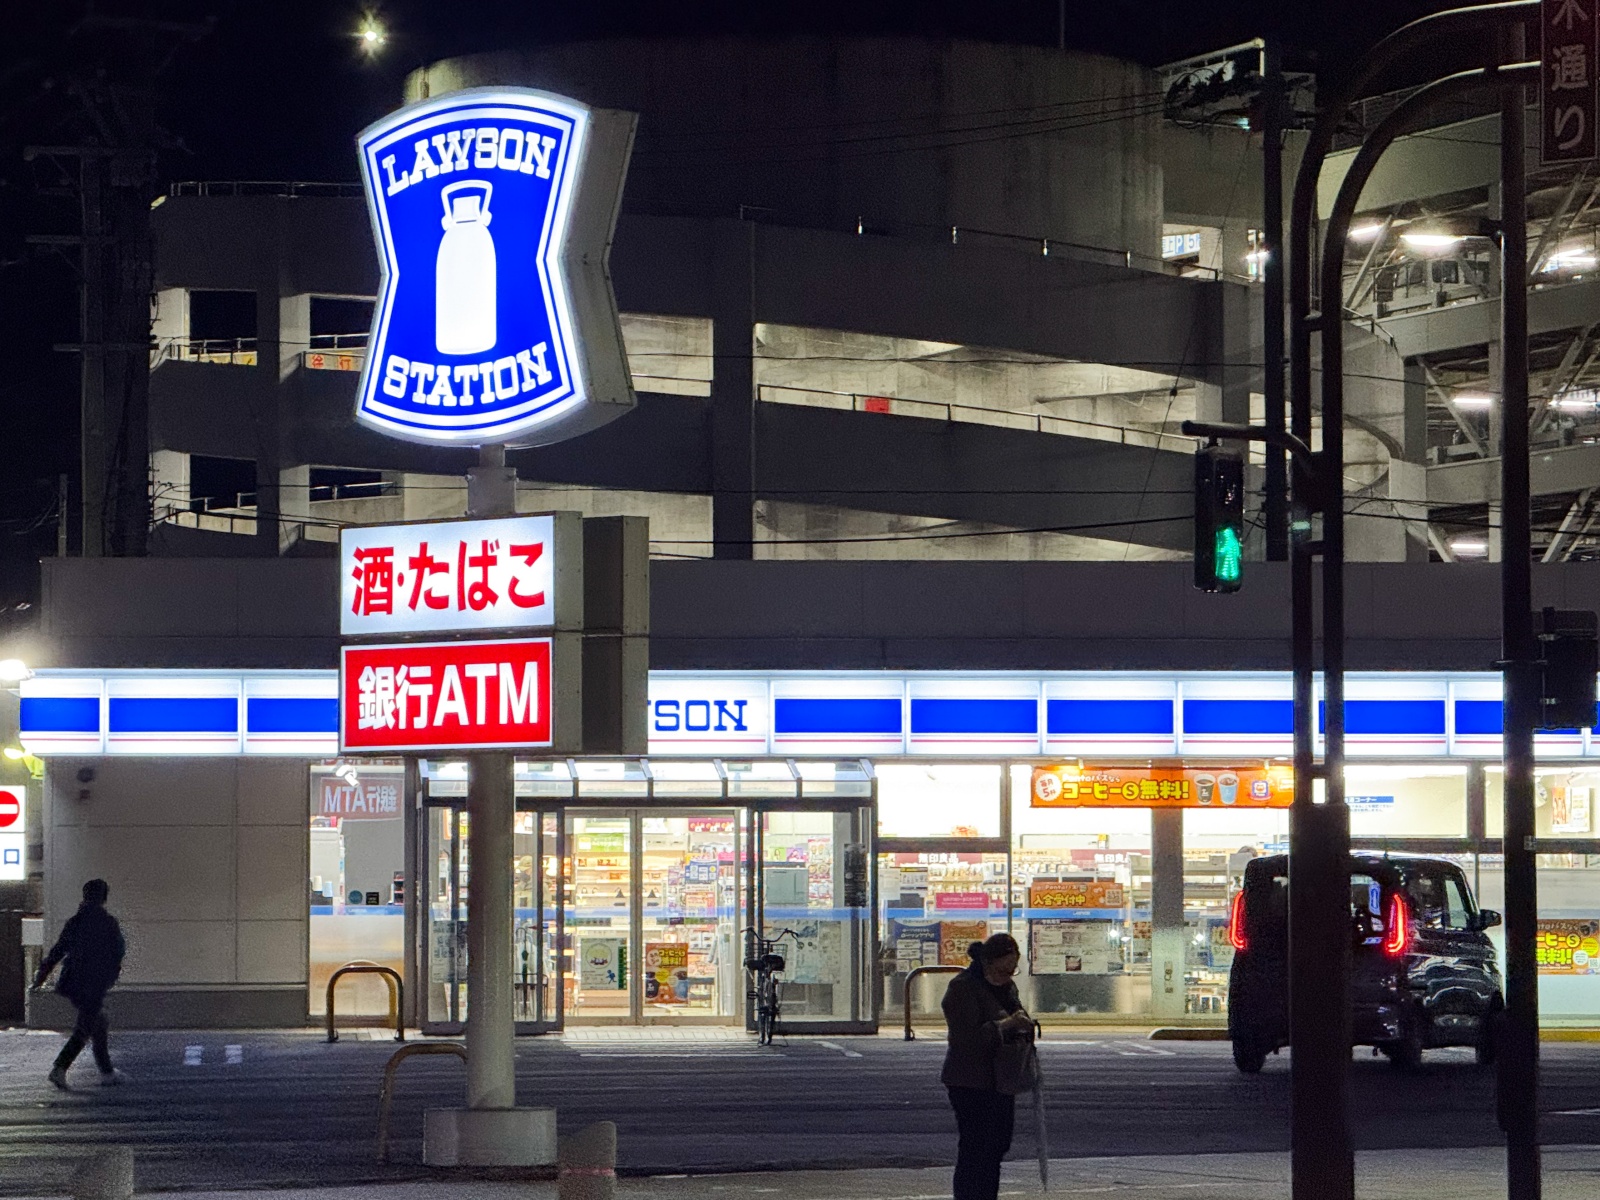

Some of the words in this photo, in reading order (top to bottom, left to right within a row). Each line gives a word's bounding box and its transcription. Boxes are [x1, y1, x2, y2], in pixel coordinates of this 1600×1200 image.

[381, 127, 556, 197] LAWSON
[382, 341, 552, 407] STATION
[357, 661, 539, 730] 銀行ATM
[648, 699, 748, 732] SON
[4, 849, 20, 865] 口
[917, 852, 960, 864] 無印良品
[1094, 853, 1128, 863] 無印良
[1033, 893, 1086, 906] 入会受付中
